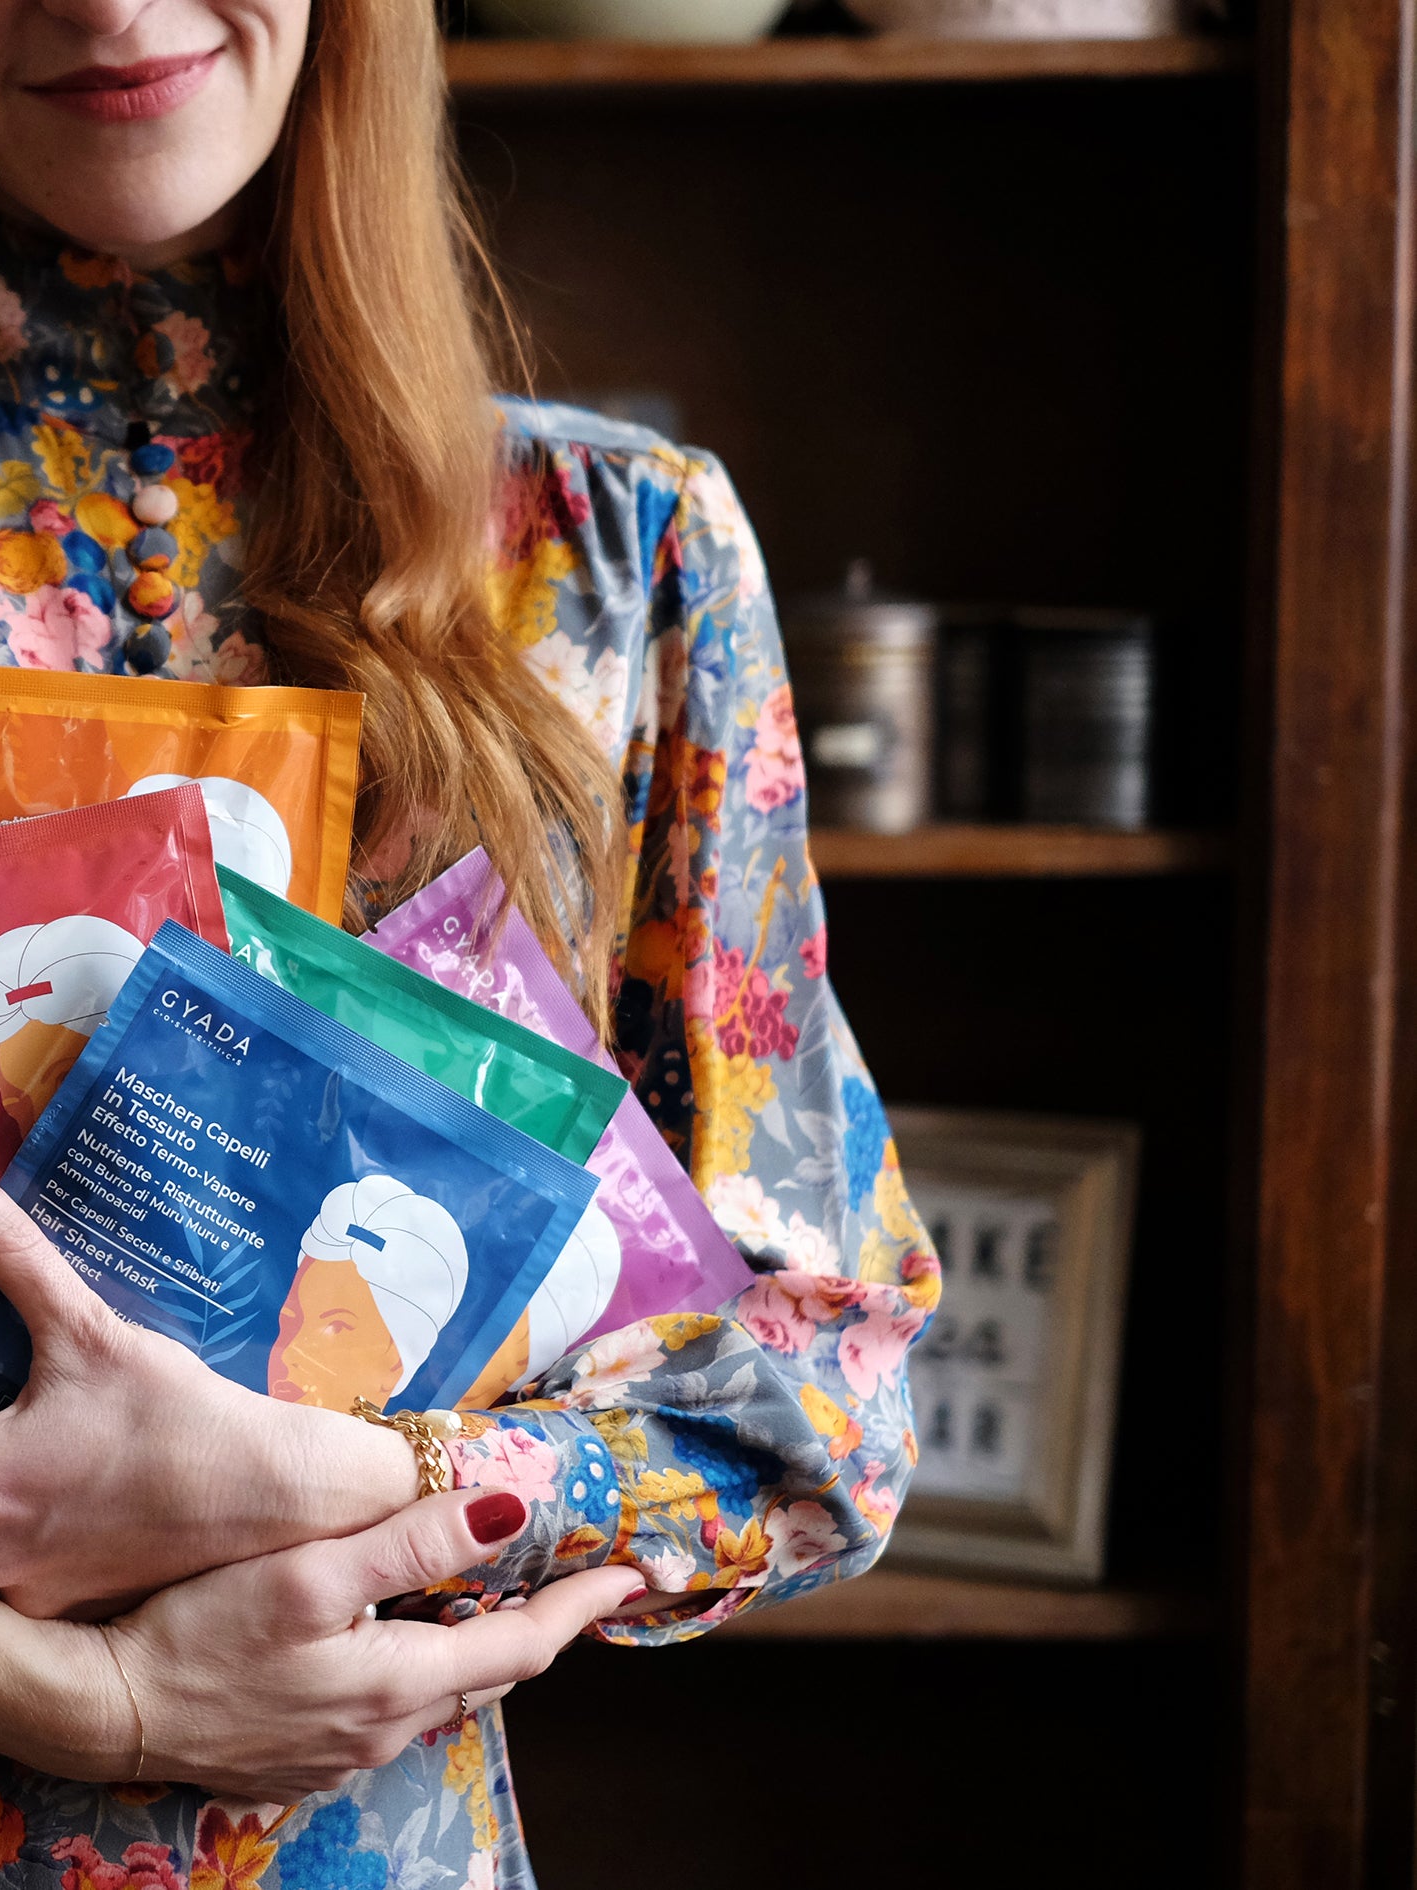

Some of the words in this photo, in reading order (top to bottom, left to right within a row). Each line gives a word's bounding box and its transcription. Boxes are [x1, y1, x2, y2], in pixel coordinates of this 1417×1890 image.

[161, 989, 250, 1056] GYADA
[91, 1105, 147, 1147] Effetto
[150, 1138, 256, 1212] Termo-Vapore
[102, 1084, 123, 1108] in
[128, 1098, 196, 1151] Tessuto
[114, 1066, 203, 1131] Maschera
[206, 1122, 271, 1169] Capelli
[45, 1179, 70, 1200] Per
[70, 1196, 118, 1231] Capelli
[116, 1225, 163, 1259] Secchi
[161, 1255, 171, 1265] e
[172, 1259, 223, 1294] Sfibrati
[56, 1161, 148, 1222] Amminoacidi
[67, 1147, 93, 1168] con
[93, 1162, 133, 1193] Burro
[133, 1189, 150, 1202] di
[148, 1195, 184, 1224] Muru
[185, 1217, 220, 1245] Muru
[220, 1240, 230, 1251] e
[77, 1128, 152, 1183] Nutriente
[161, 1179, 265, 1249] Ristrutturante
[29, 1202, 65, 1232] Hair
[64, 1228, 113, 1266] Sheet
[114, 1259, 159, 1294] Mask
[63, 1249, 102, 1282] Effect
